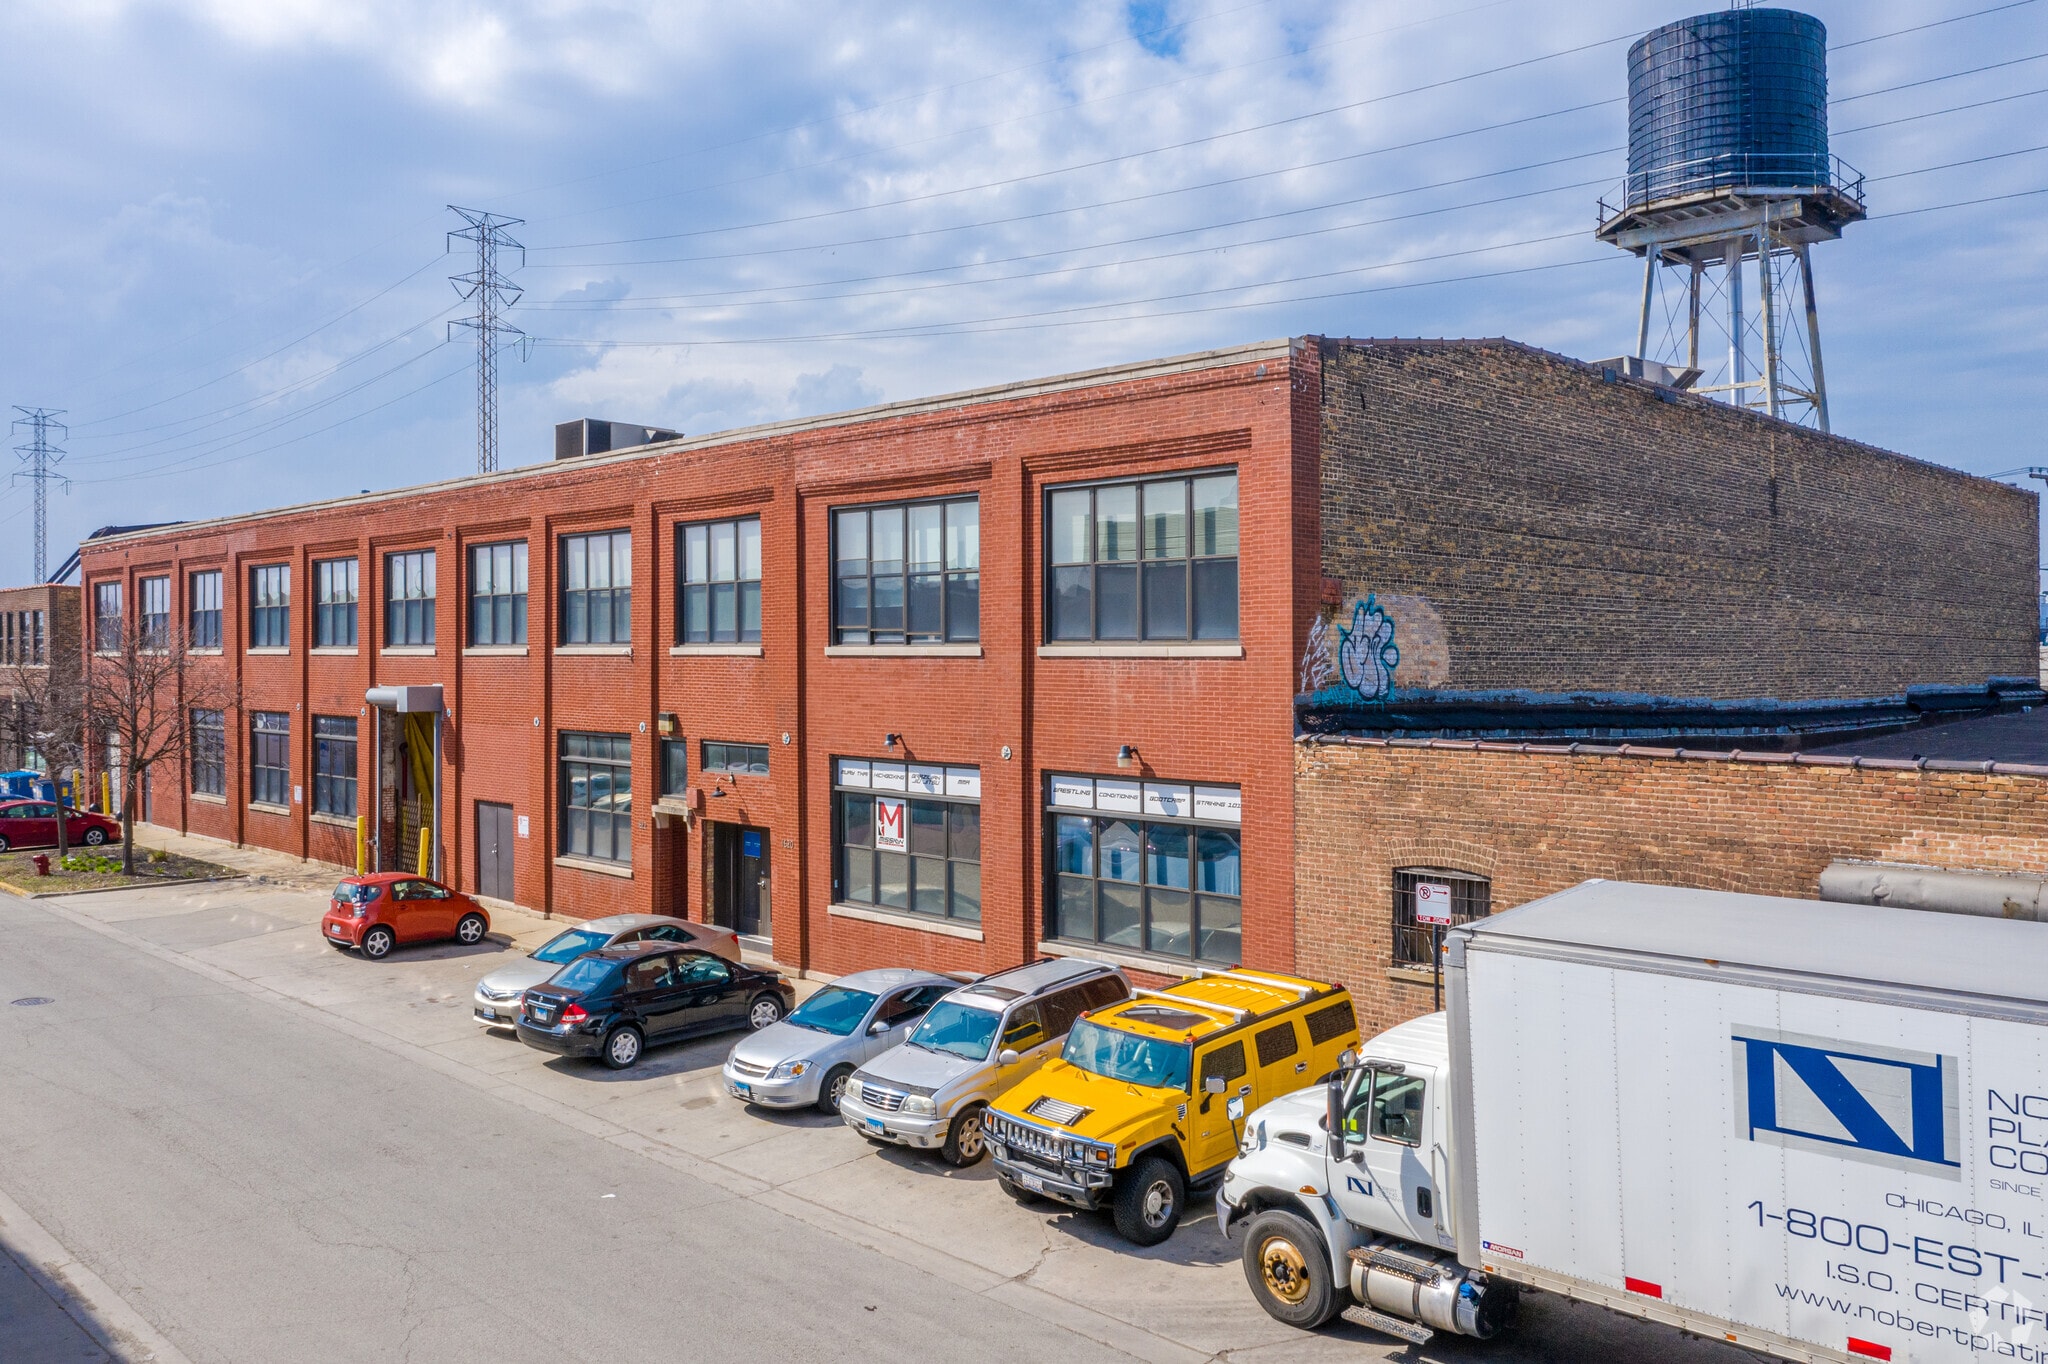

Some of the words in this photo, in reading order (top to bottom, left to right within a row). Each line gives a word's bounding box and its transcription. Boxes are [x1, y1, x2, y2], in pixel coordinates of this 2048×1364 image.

[1053, 787, 1091, 796] WRESTLING
[1098, 792, 1139, 800] CONDITIONING
[1195, 800, 1226, 808] STRIKING
[1227, 801, 1241, 809] 101
[878, 801, 904, 838] M
[1988, 1117, 2048, 1148] PL
[1989, 1179, 2042, 1198] SINCE
[1885, 1193, 2011, 1234] CHICAGO,
[2022, 1221, 2043, 1239] IL
[1748, 1200, 2048, 1283] 1-800-EST-
[1826, 1260, 1900, 1295] I.S.O.
[1915, 1283, 2048, 1331] CERTIF
